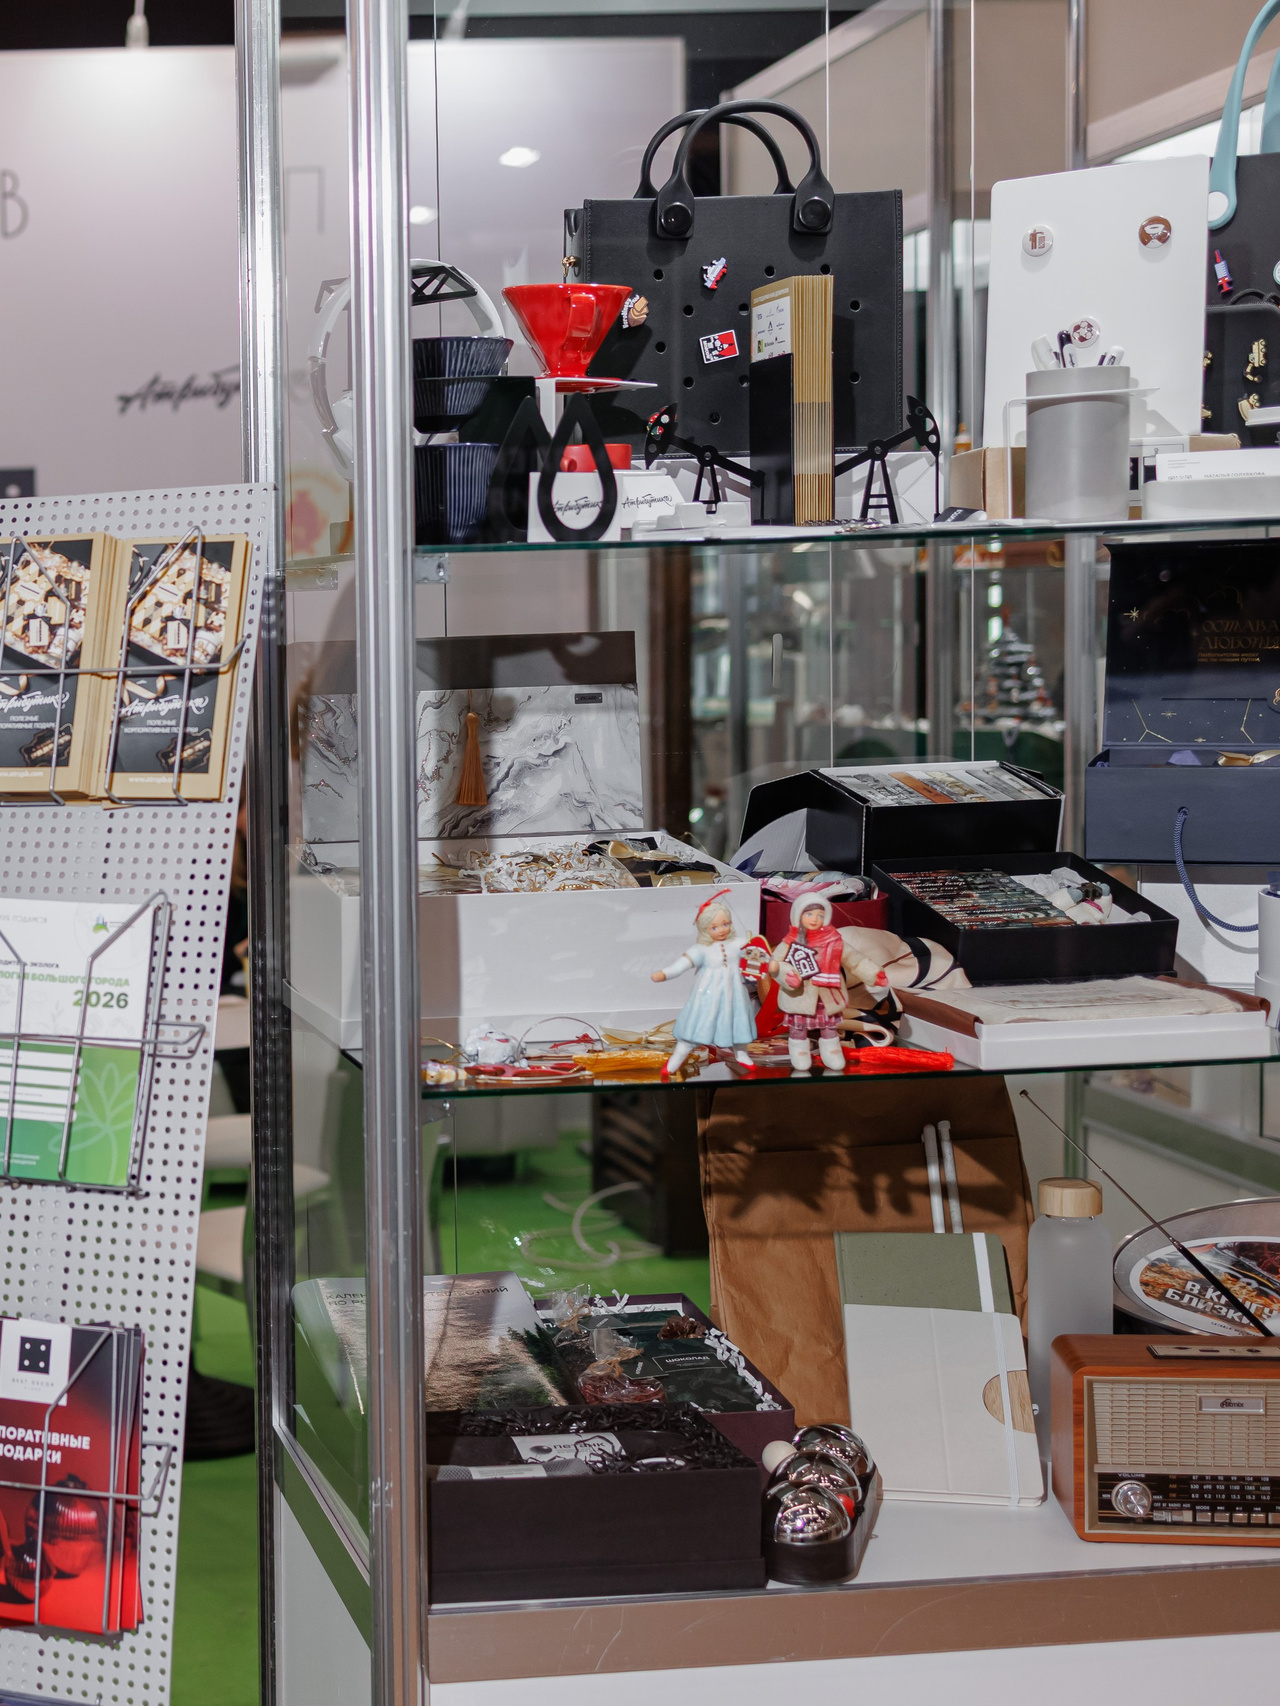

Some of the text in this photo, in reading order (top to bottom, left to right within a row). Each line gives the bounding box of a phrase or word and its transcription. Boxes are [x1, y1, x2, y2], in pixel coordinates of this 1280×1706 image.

[120, 694, 209, 717] Атрибутка
[72, 989, 129, 1009] 2026
[1165, 1287, 1255, 1327] БЛИЗК
